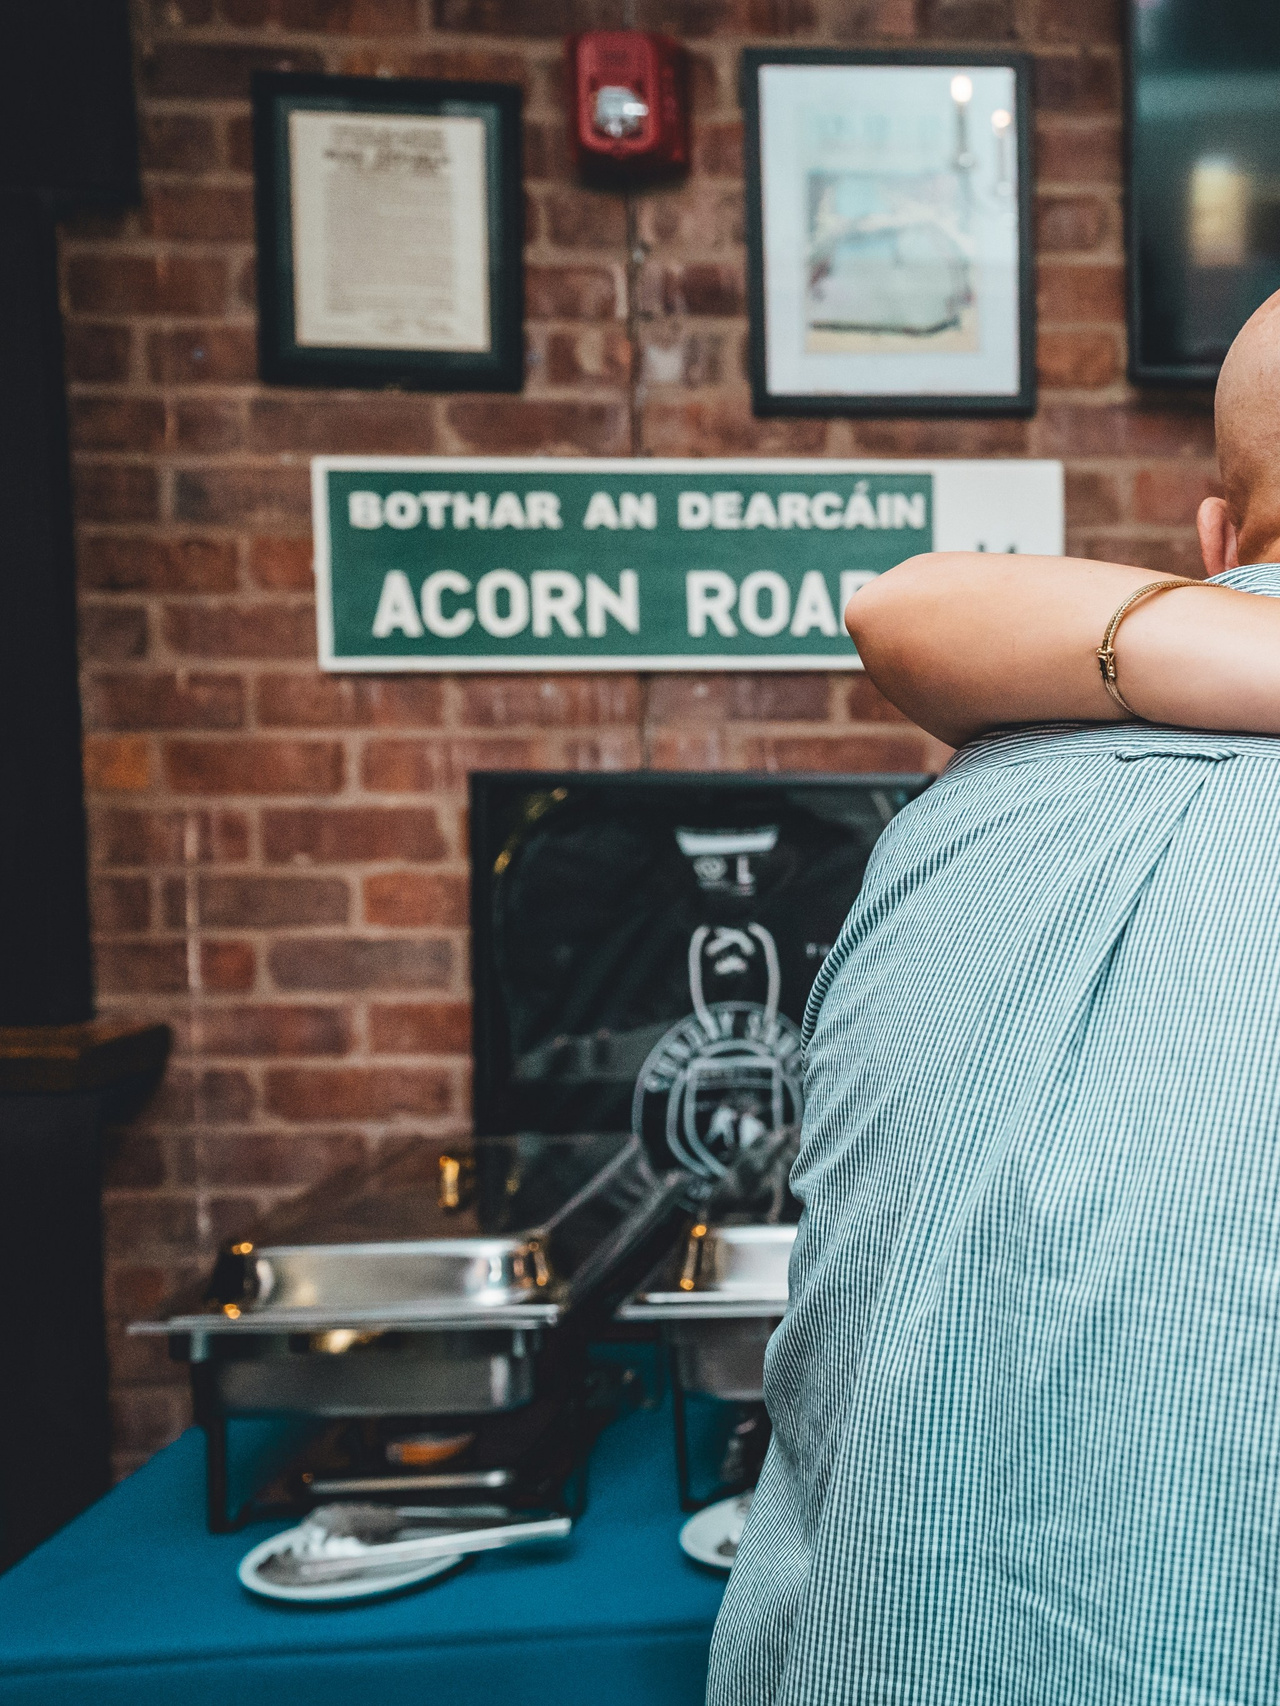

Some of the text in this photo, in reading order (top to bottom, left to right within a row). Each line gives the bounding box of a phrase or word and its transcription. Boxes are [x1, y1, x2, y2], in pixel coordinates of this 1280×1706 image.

[348, 481, 927, 531] BOTHAR AN DEARCÁIN
[372, 569, 640, 638] ACORN
